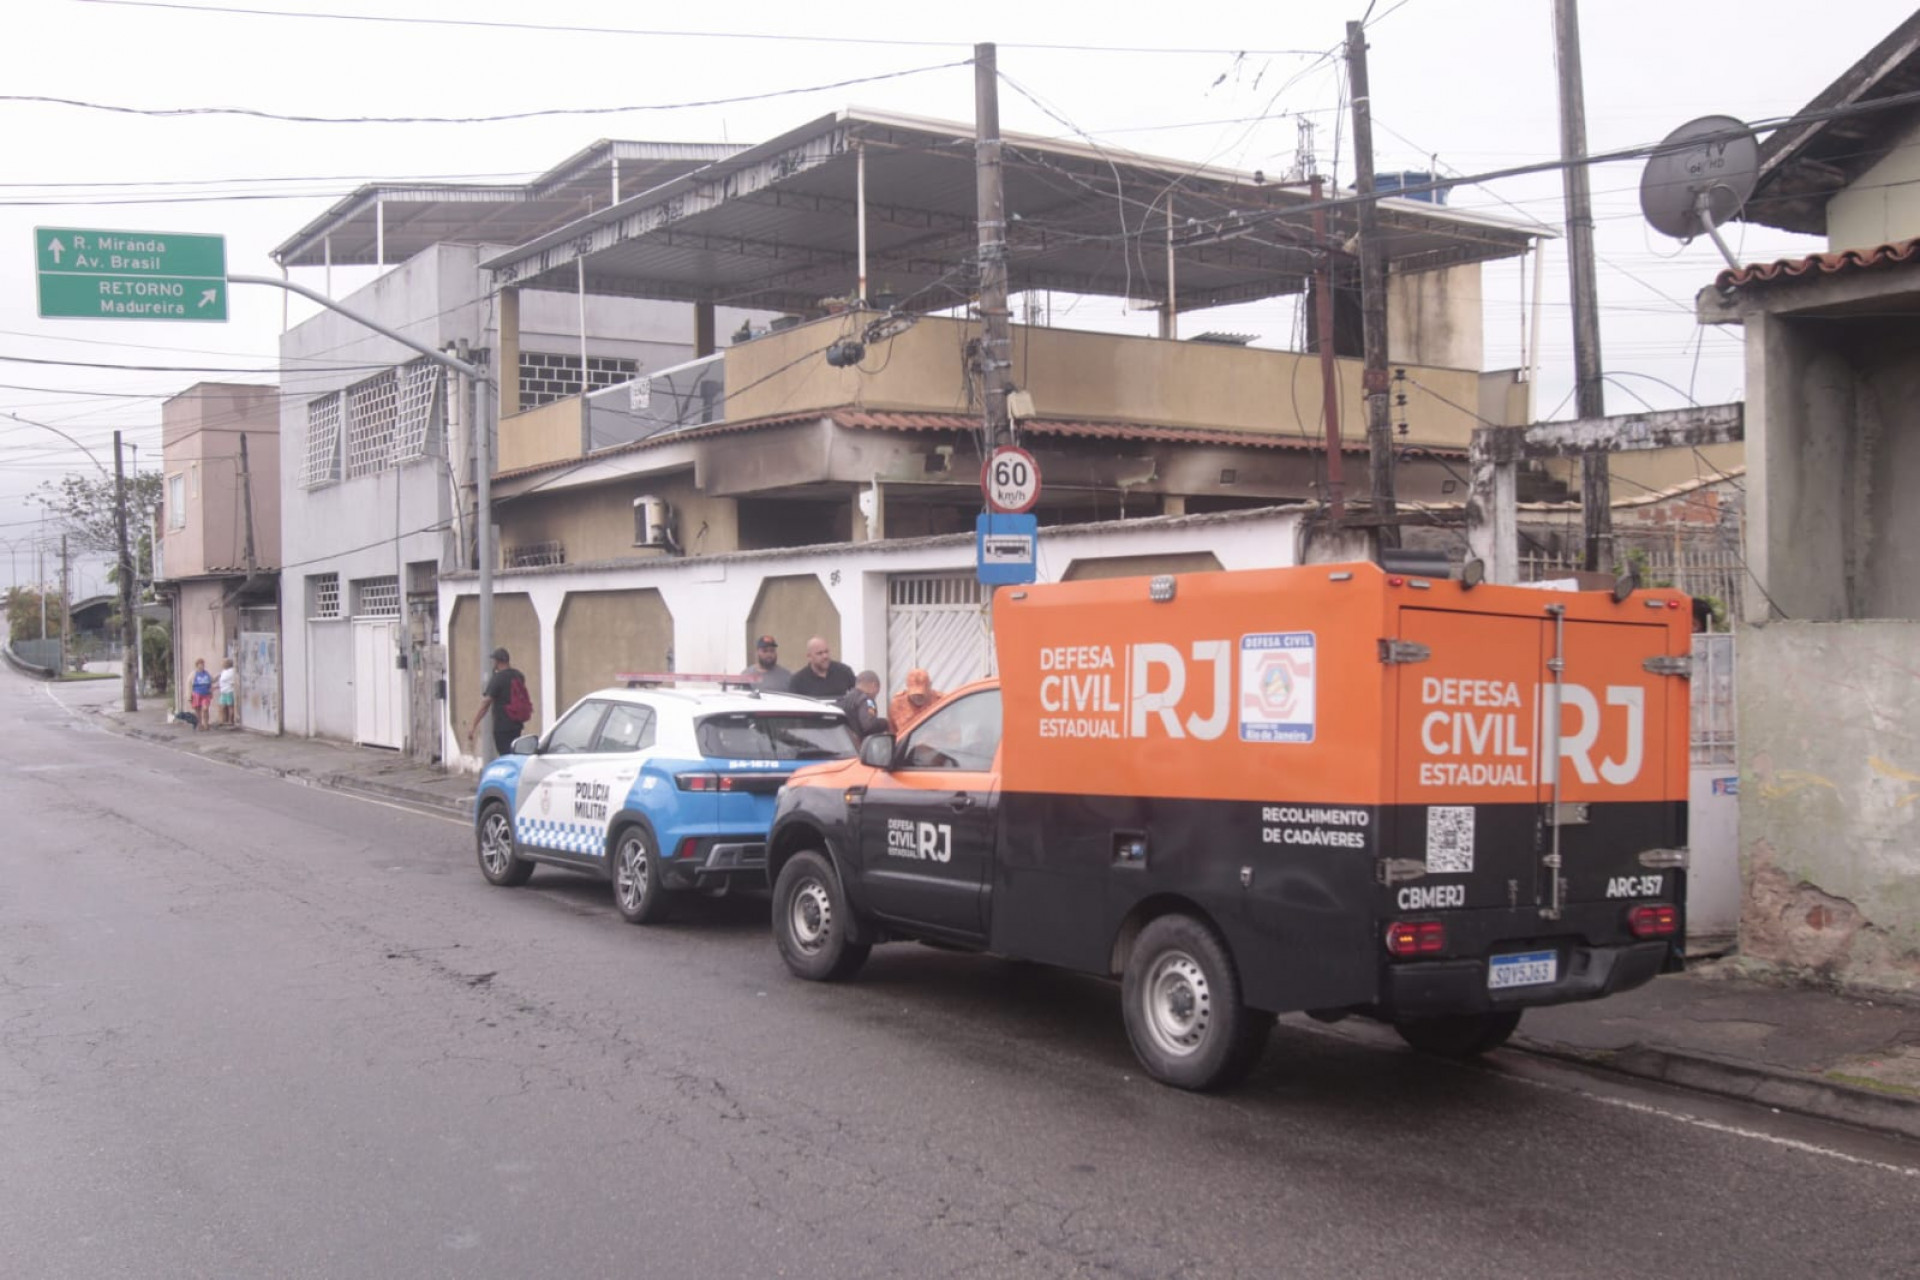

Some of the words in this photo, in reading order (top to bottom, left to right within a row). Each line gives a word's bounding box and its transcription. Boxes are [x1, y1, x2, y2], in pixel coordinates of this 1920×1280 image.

[73, 236, 91, 249] R.
[98, 237, 166, 252] Miranda
[76, 254, 104, 268] Av.
[111, 255, 160, 270] Brasil
[99, 281, 184, 296] RETORNO
[100, 299, 185, 314] Madureira
[995, 461, 1027, 487] 60
[998, 490, 1026, 502] km/h
[1245, 636, 1281, 647] DEFESA
[1284, 635, 1310, 646] CIVIL
[1040, 645, 1115, 670] DEFESA
[1040, 675, 1120, 712] CIVIL
[1131, 639, 1232, 740] RJ
[1422, 677, 1522, 707] DEFESA
[1039, 718, 1120, 739] ESTADUAL
[1421, 711, 1528, 756] CIVIL
[1541, 683, 1645, 785] RJ
[1420, 763, 1527, 786] ESTADUAL
[575, 779, 610, 802] POLÍCIA
[574, 801, 607, 821] MILITAR
[1262, 807, 1369, 826] RECOLHIMENTO
[888, 818, 914, 831] DEFESA
[888, 830, 916, 848] CIVIL
[919, 821, 952, 862] RJ
[1262, 828, 1281, 843] DE
[1283, 827, 1365, 848] CADÁVERES
[1397, 885, 1465, 910] CBMERJ
[1606, 875, 1663, 898] ARC-157
